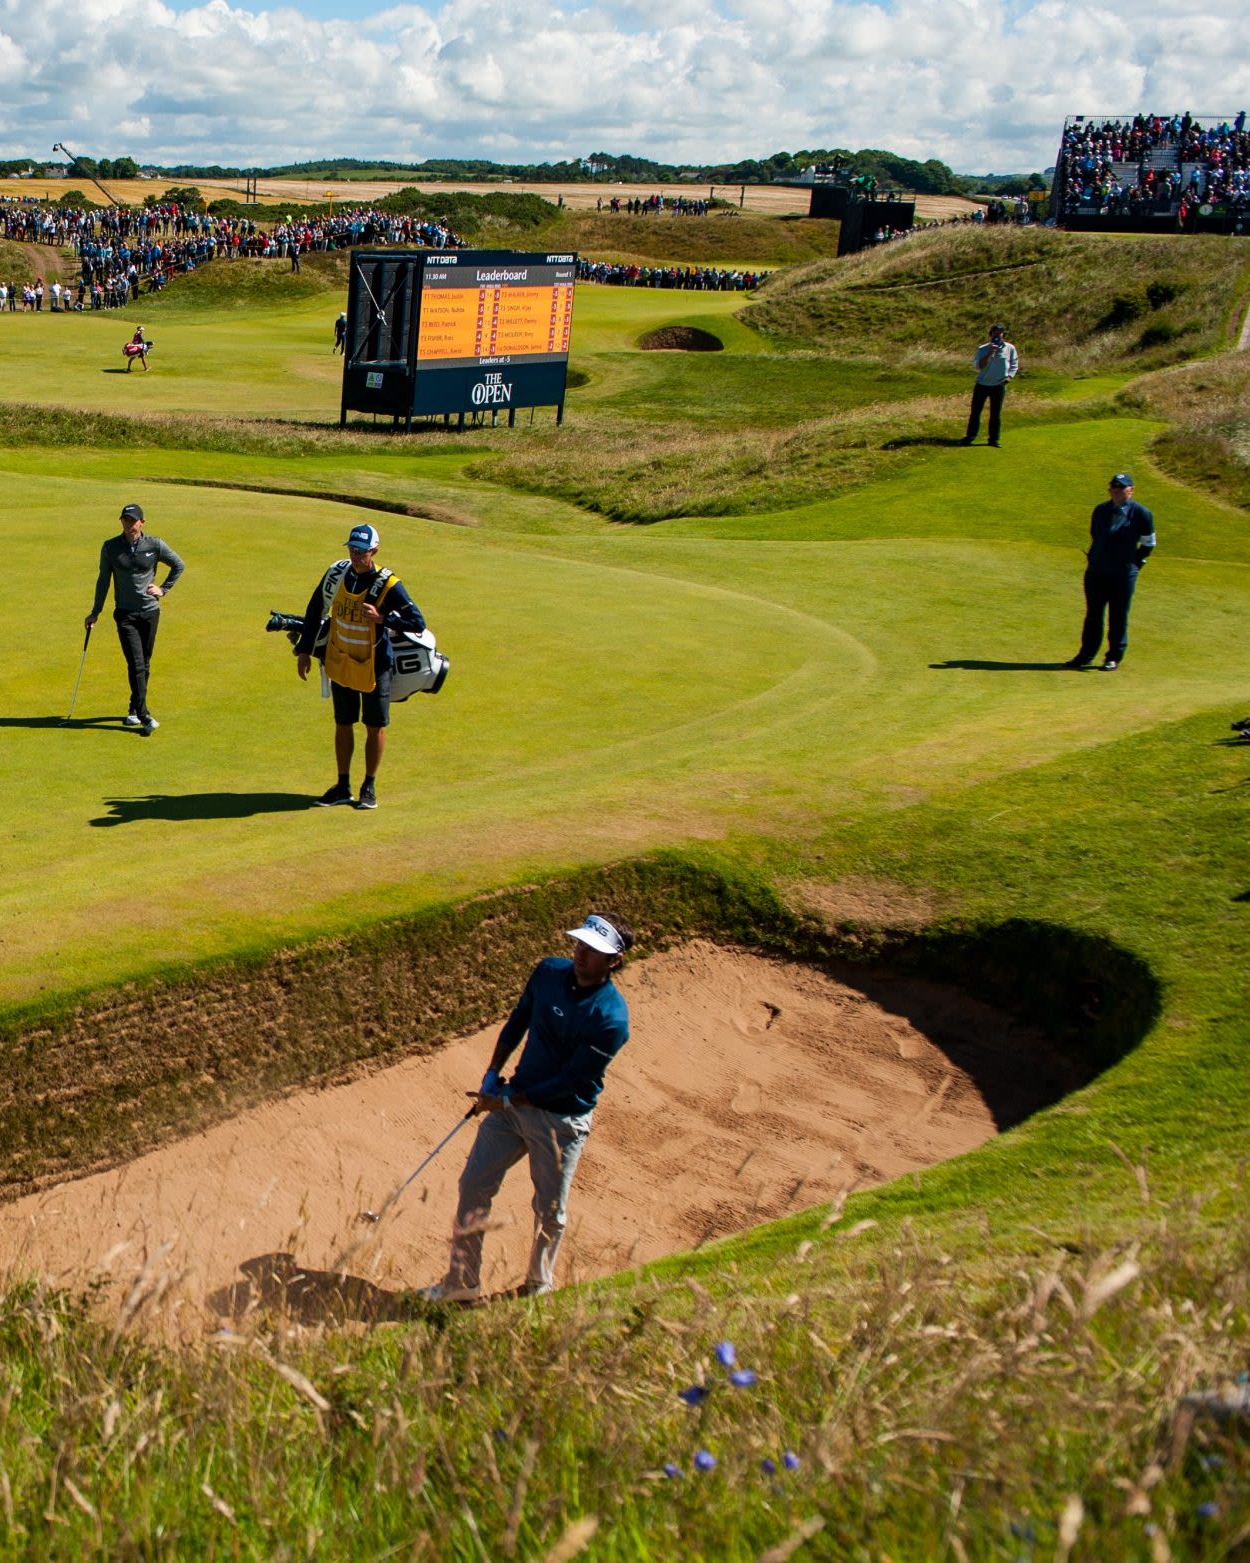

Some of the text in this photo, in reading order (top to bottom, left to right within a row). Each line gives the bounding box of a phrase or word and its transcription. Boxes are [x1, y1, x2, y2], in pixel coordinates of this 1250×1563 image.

[476, 269, 528, 281] Leaderboard
[480, 356, 498, 364] Leaders
[485, 372, 502, 384] THE
[472, 383, 513, 405] OPEN
[325, 560, 350, 595] PING
[370, 568, 392, 597] PING
